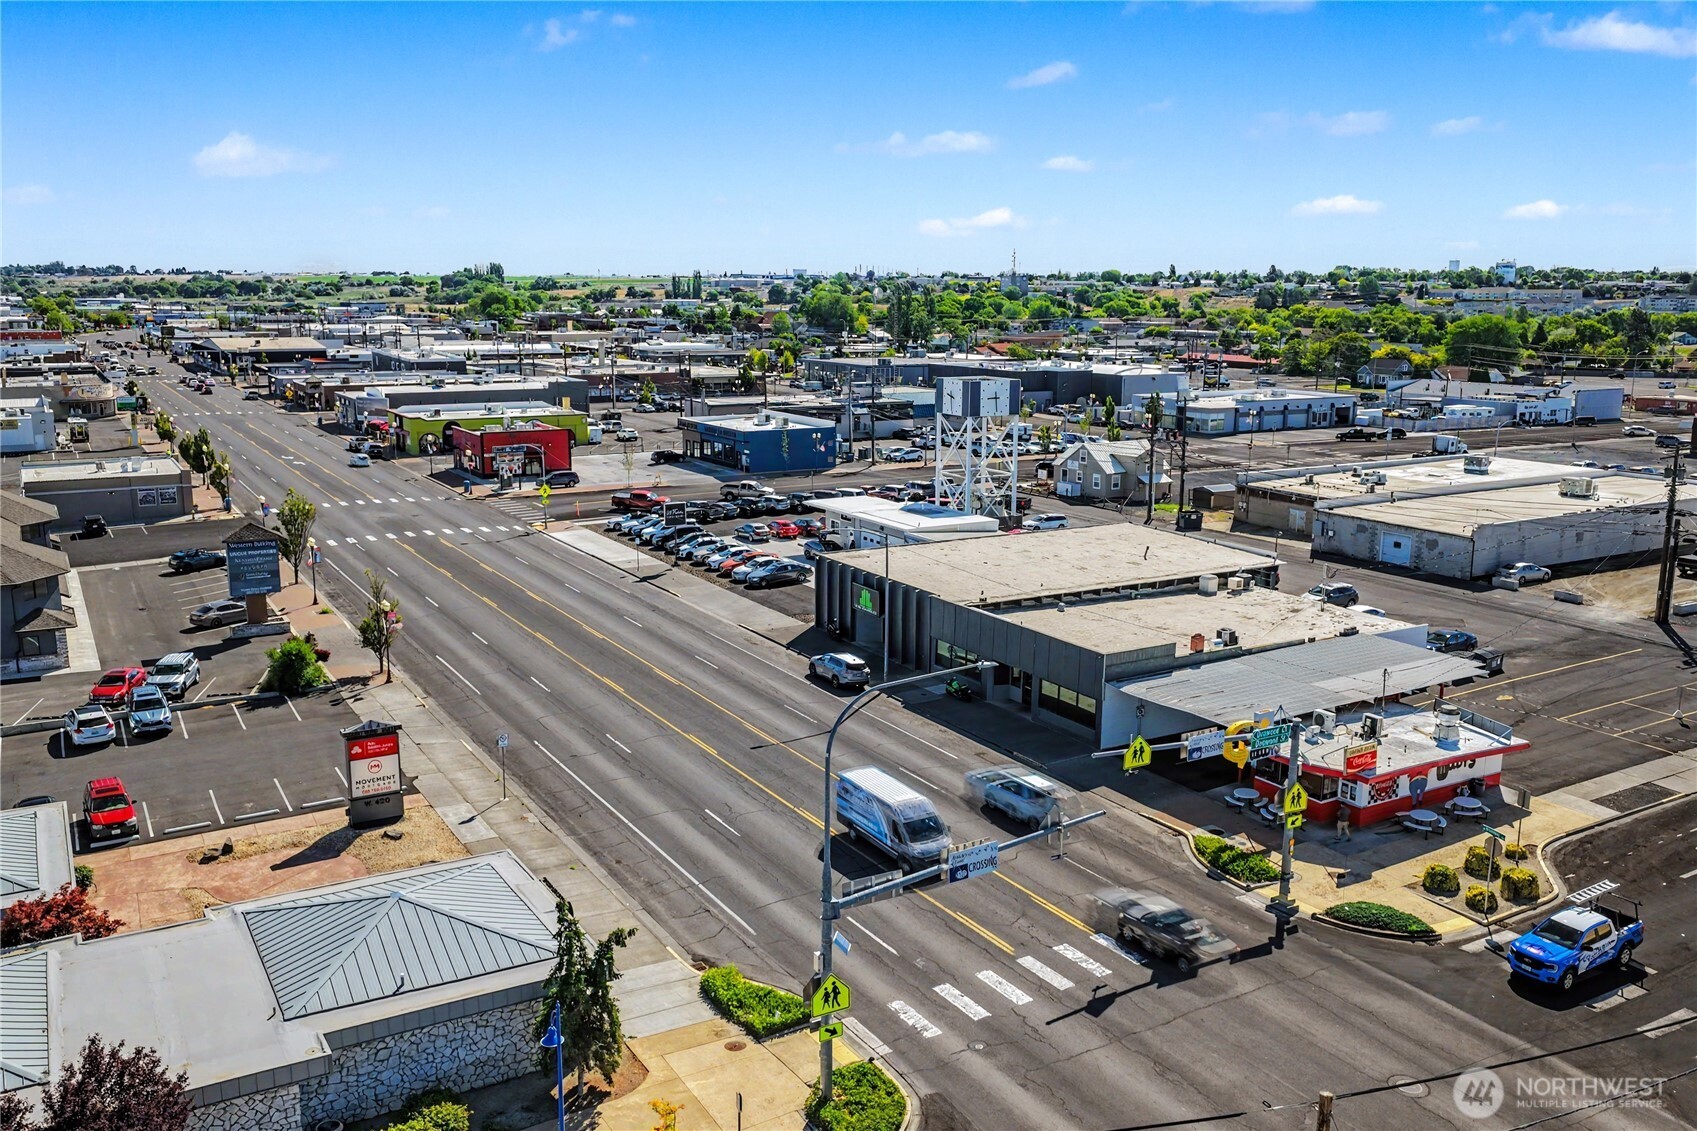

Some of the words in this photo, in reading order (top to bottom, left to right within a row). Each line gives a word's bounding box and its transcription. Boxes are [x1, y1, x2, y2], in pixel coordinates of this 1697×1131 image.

[356, 775, 396, 785] MOVEMENT
[356, 781, 396, 789] MORTGAGE
[968, 855, 998, 872] CROSSING
